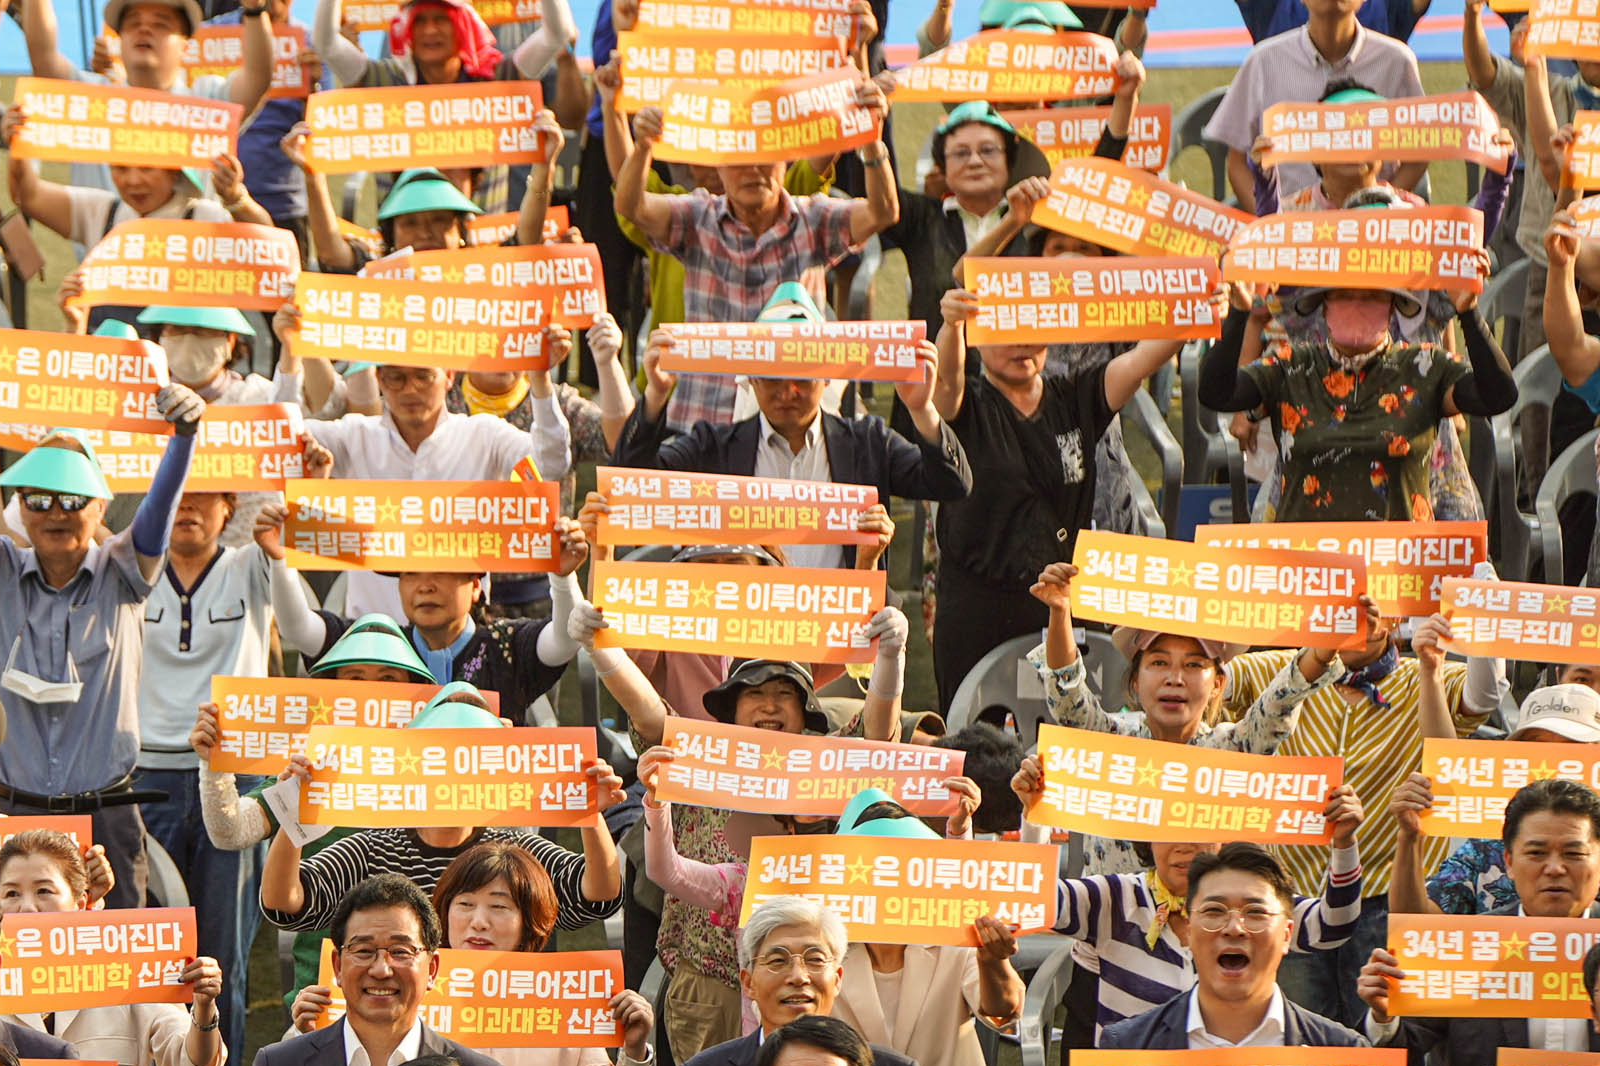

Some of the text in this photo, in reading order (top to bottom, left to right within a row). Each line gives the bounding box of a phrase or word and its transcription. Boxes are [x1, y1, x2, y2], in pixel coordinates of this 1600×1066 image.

[293, 495, 348, 523] 34년
[429, 495, 550, 526] 이루어진다
[295, 527, 552, 565] 국립목포대 의과대학 신설
[1083, 549, 1138, 583] 34년
[1227, 563, 1356, 598] 이루어진다
[604, 577, 658, 607] 34년
[745, 582, 873, 615] 이루어진다
[1079, 584, 1357, 634] 국립목포대 의과대학 신설
[727, 617, 822, 647] 의과대학
[1531, 696, 1581, 715] Golden
[311, 743, 363, 775] 34년
[455, 743, 584, 776] 이루어진다
[1046, 745, 1104, 781] 34년
[1195, 766, 1329, 803] 이루어진다
[308, 781, 588, 812] 국립목포대 의과대학 신설
[1042, 780, 1326, 835] 국립목포대 의과대학 신설
[49, 921, 183, 956] 이루어진다
[31, 959, 186, 995] 의과대학 신설
[481, 968, 614, 1000] 이루어진다
[457, 1006, 616, 1035] 의과대학 신설
